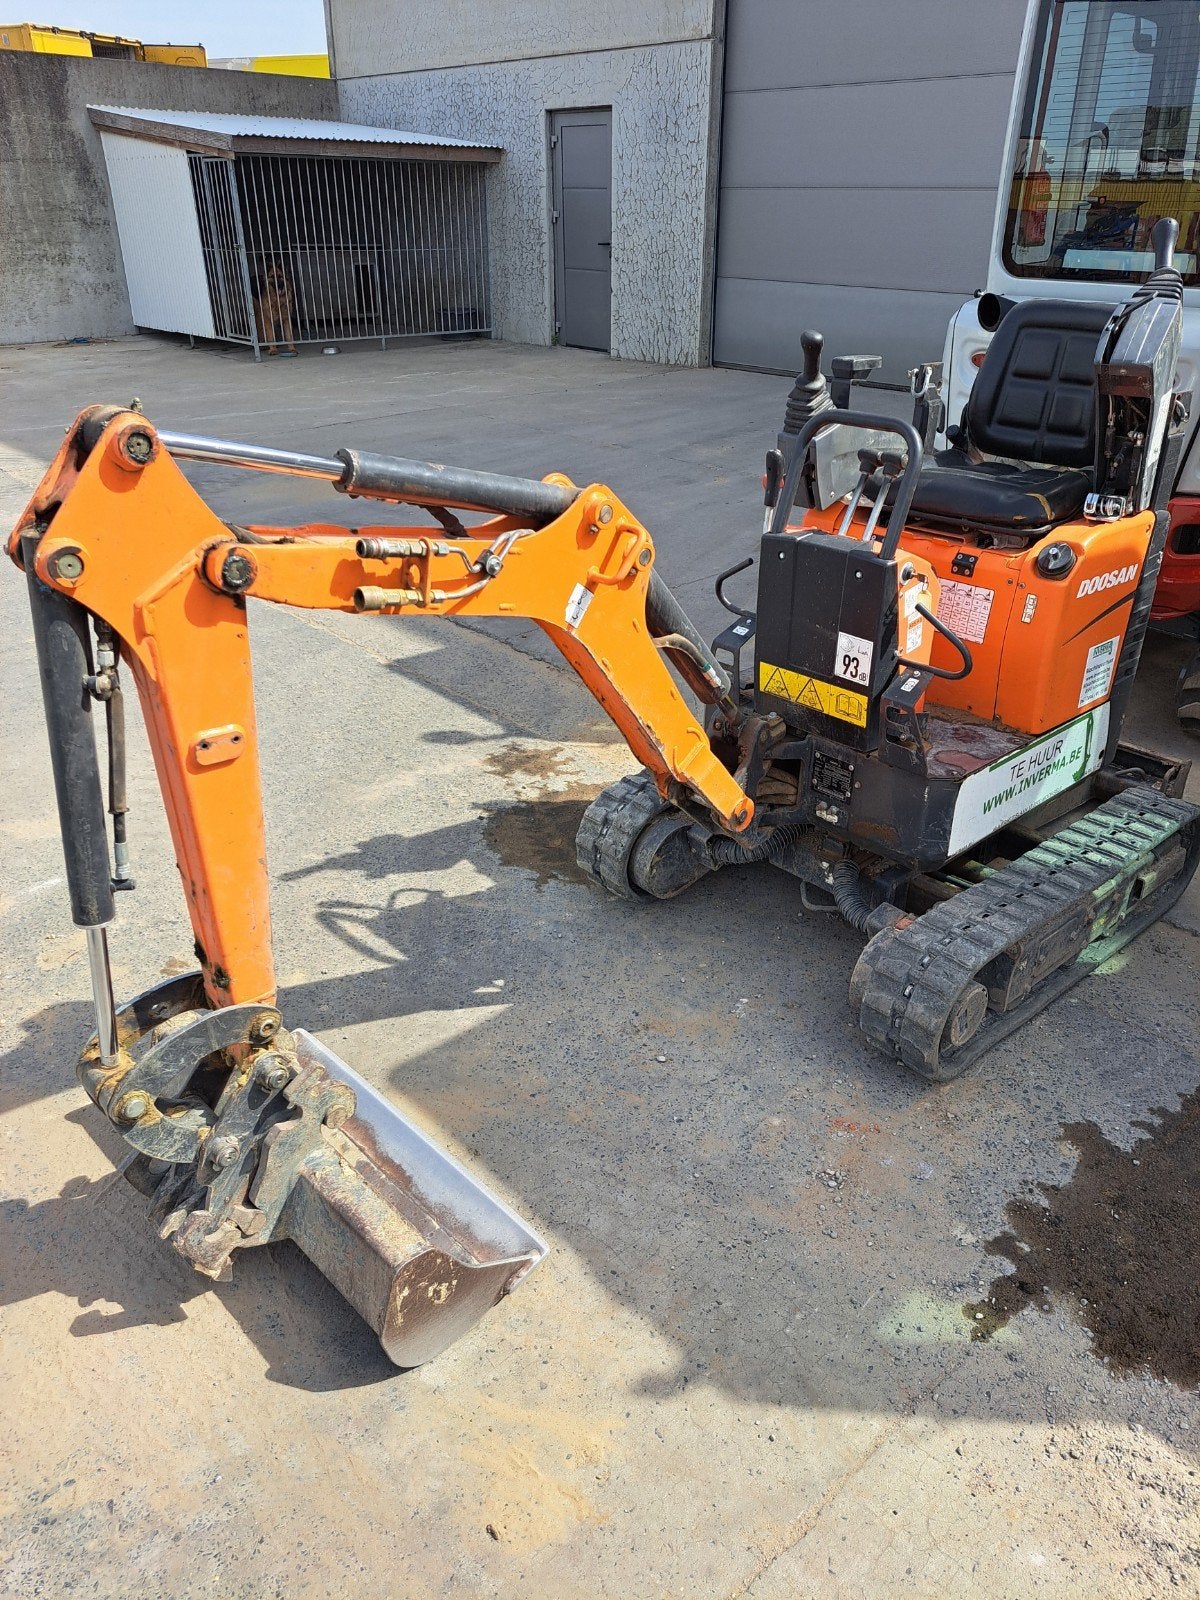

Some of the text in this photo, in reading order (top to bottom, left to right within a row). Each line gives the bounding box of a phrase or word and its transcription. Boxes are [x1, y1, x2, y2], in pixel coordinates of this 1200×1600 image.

[1077, 564, 1138, 599] DOOSAN
[843, 654, 860, 679] 93
[1010, 739, 1063, 782] TE HUUR
[983, 746, 1083, 815] WWW.INVERMA.BE
